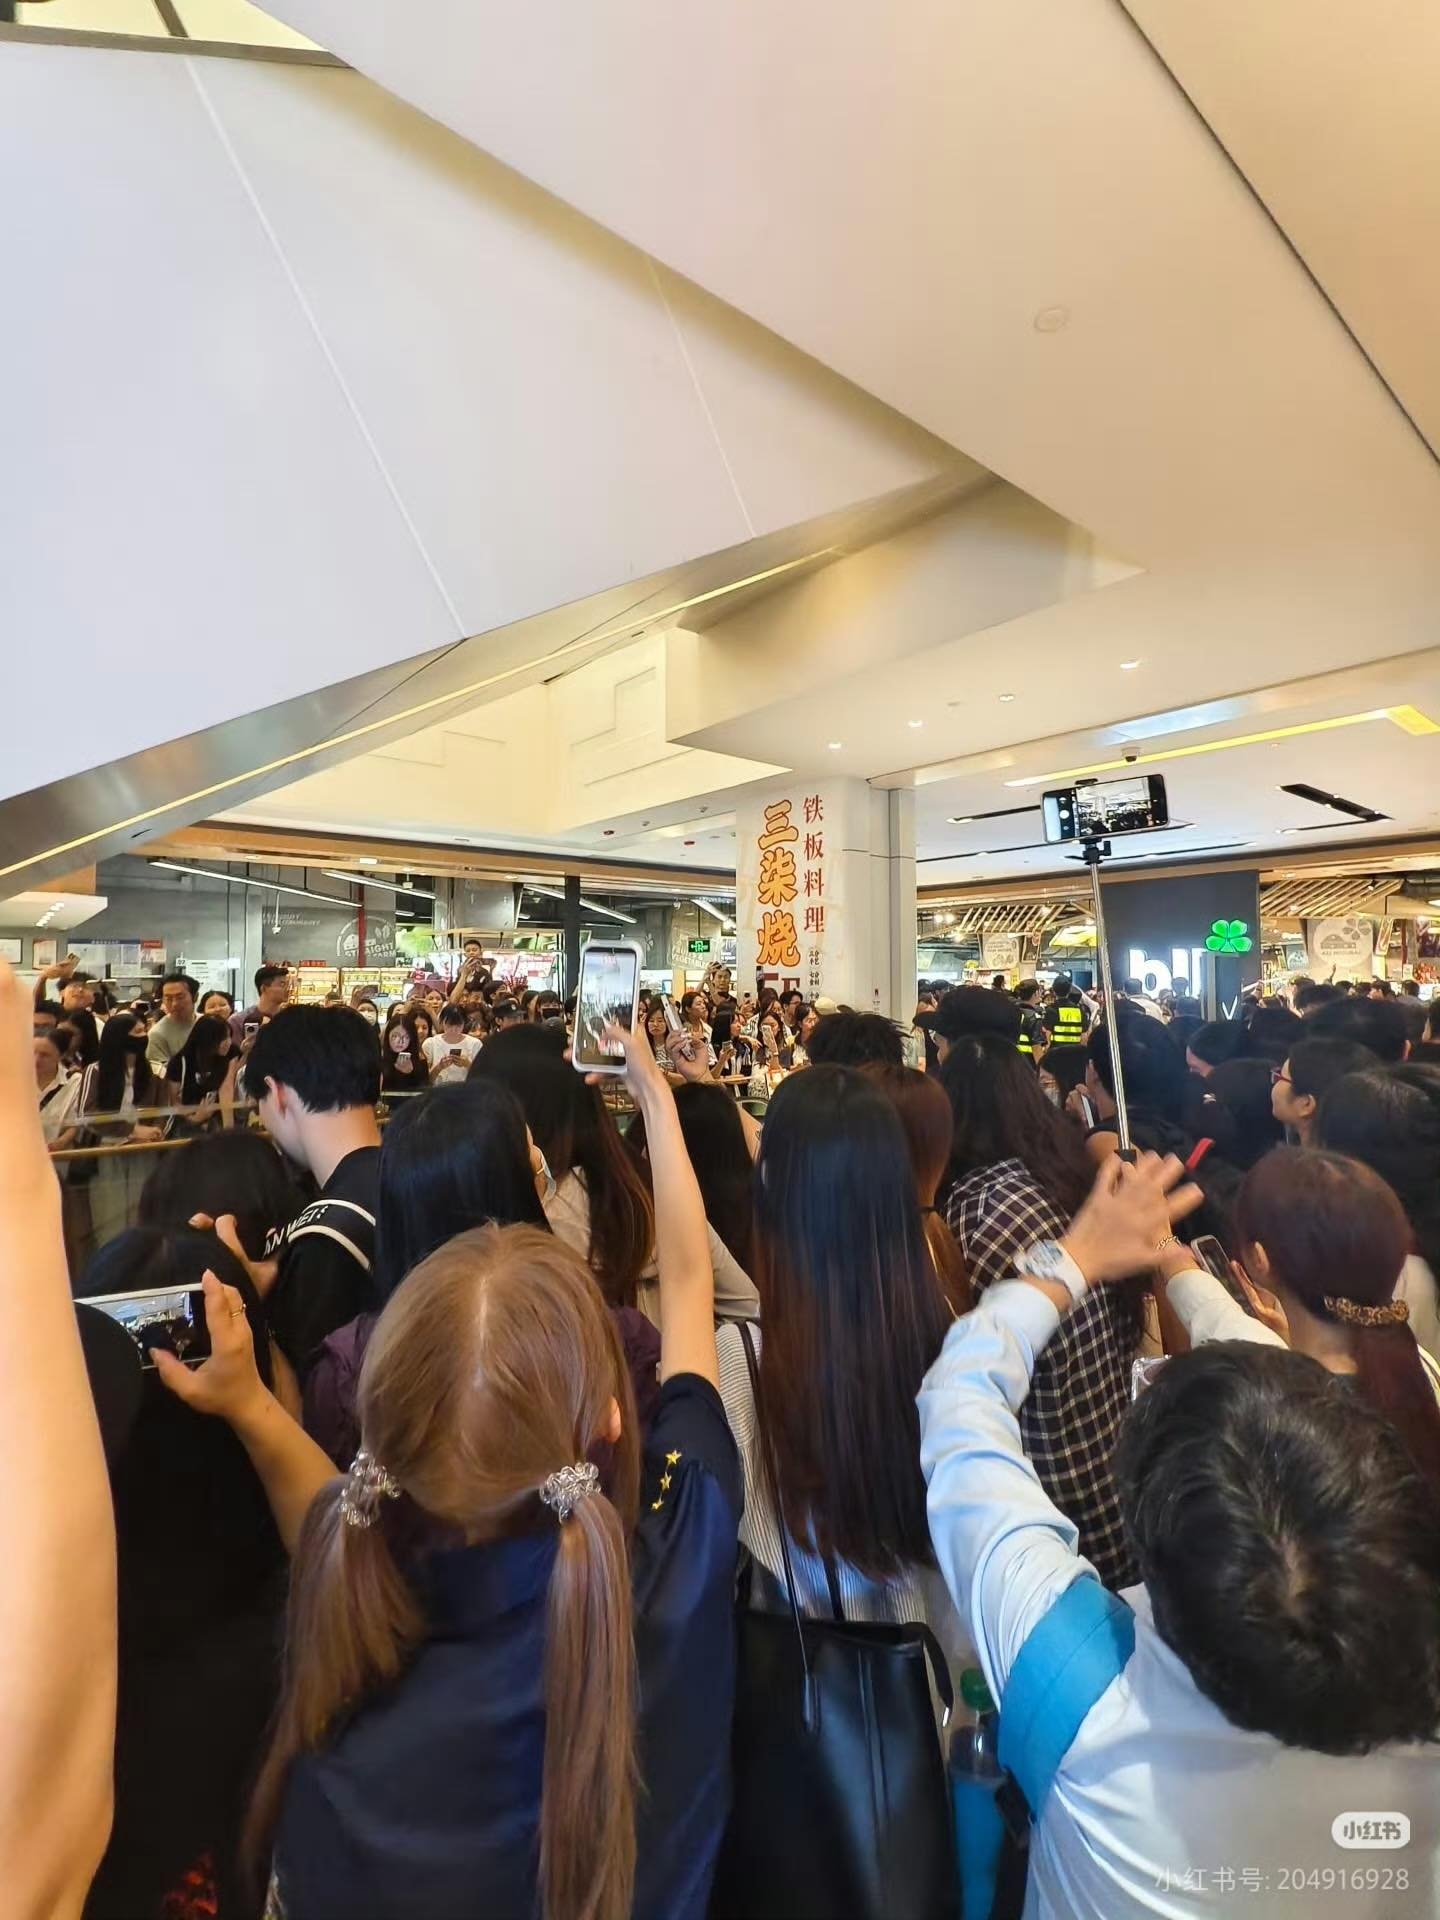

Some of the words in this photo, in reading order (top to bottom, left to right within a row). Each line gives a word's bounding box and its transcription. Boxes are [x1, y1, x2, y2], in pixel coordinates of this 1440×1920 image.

[803, 794, 824, 933] 铁板料理
[345, 942, 393, 957] STAIGHT
